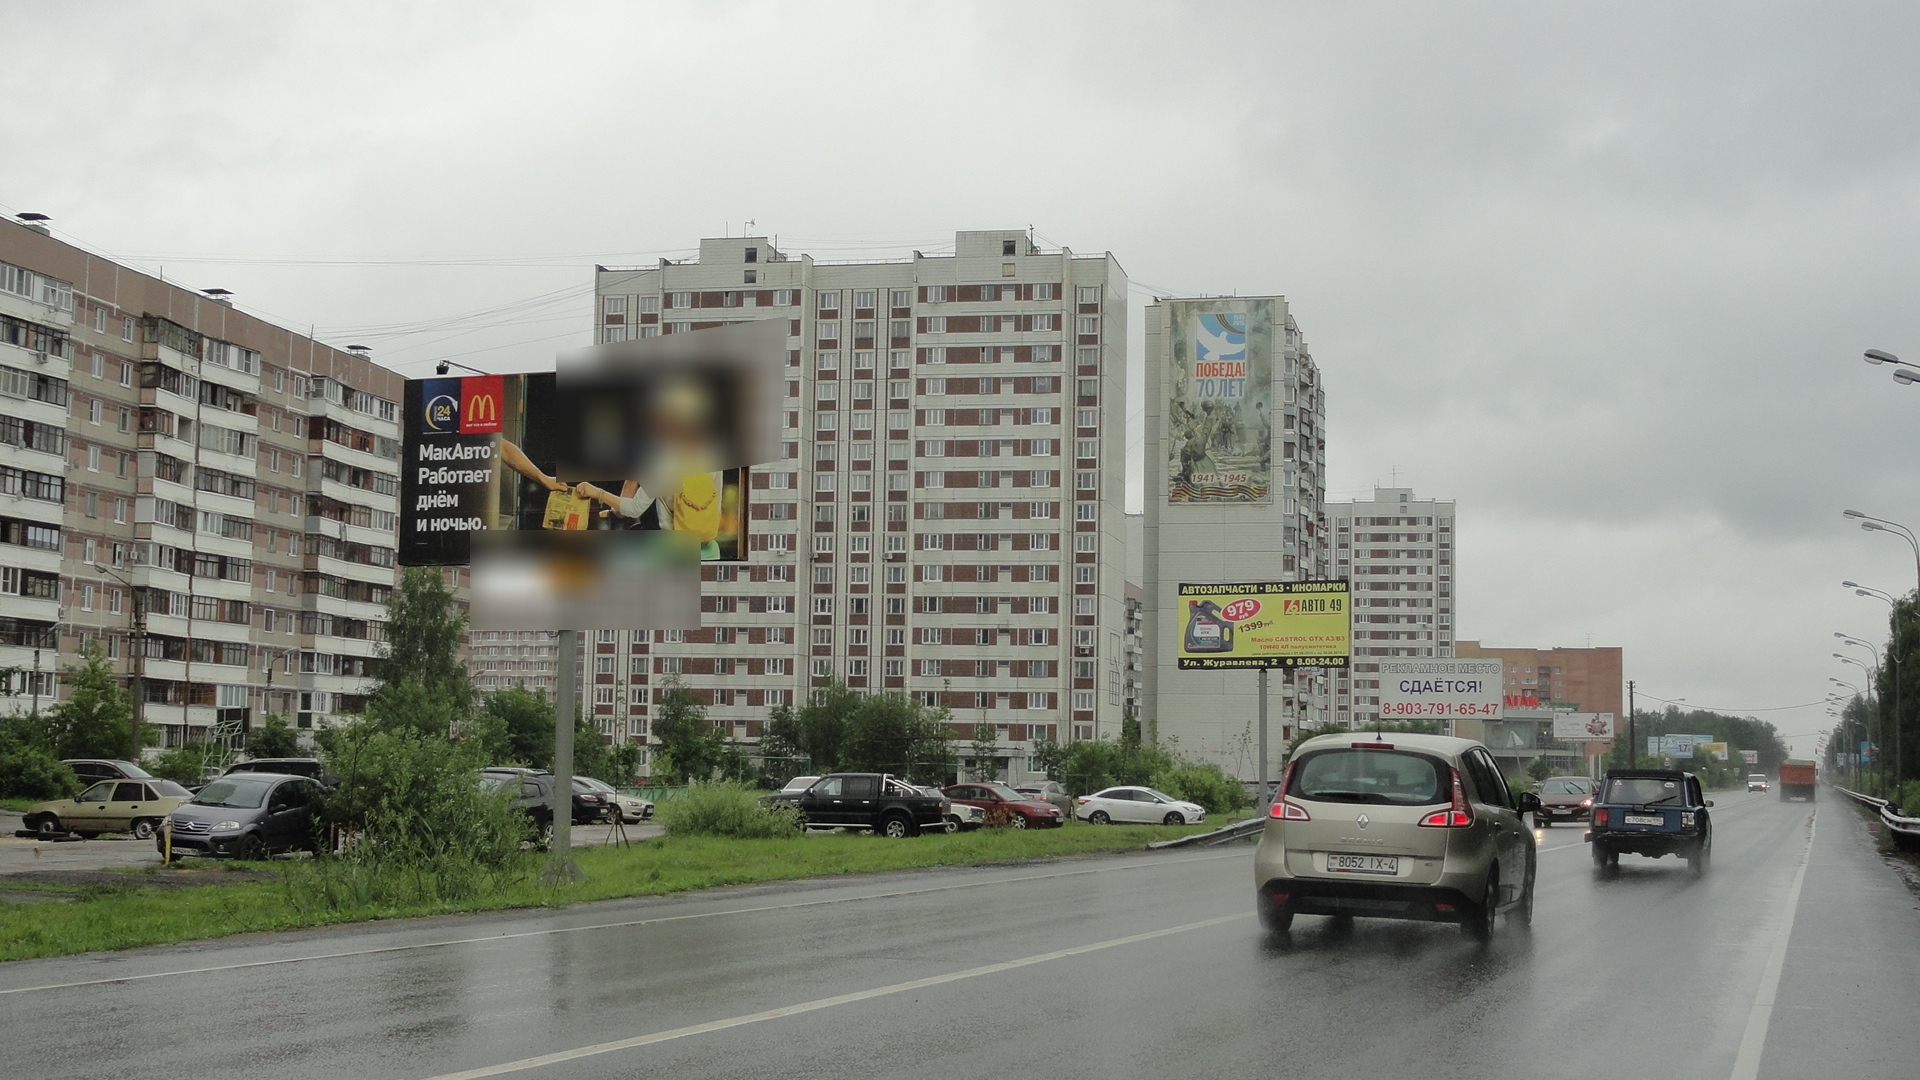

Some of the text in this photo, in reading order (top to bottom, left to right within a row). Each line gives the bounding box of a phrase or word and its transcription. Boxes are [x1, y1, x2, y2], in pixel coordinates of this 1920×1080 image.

[1195, 361, 1246, 378] ПОБЕДА!
[1197, 378, 1246, 398] 70 ЛЕТ
[437, 406, 451, 417] 24
[418, 467, 492, 485] Работает
[1192, 473, 1215, 483] 1941
[1223, 473, 1247, 483] 1945
[416, 490, 458, 511] днём
[416, 517, 487, 532] и ночью.
[1182, 583, 1347, 595] АВТОЗАПЧАСТИ ВАЗ ИНОМАРКИ
[1227, 600, 1255, 616] 979
[1301, 599, 1342, 612] АВТО 49
[1239, 620, 1263, 632] 1399
[1183, 659, 1200, 667] Ул.
[1203, 659, 1267, 668] Журавлева,
[1297, 658, 1344, 666] 8.00-24.00
[1381, 663, 1501, 674] РЕКЛАМНОЕ МЕСТО
[1399, 677, 1482, 695] СДАЁТСЯ!
[1383, 702, 1499, 716] 8-903-791-65-47
[1339, 856, 1365, 869] 8052
